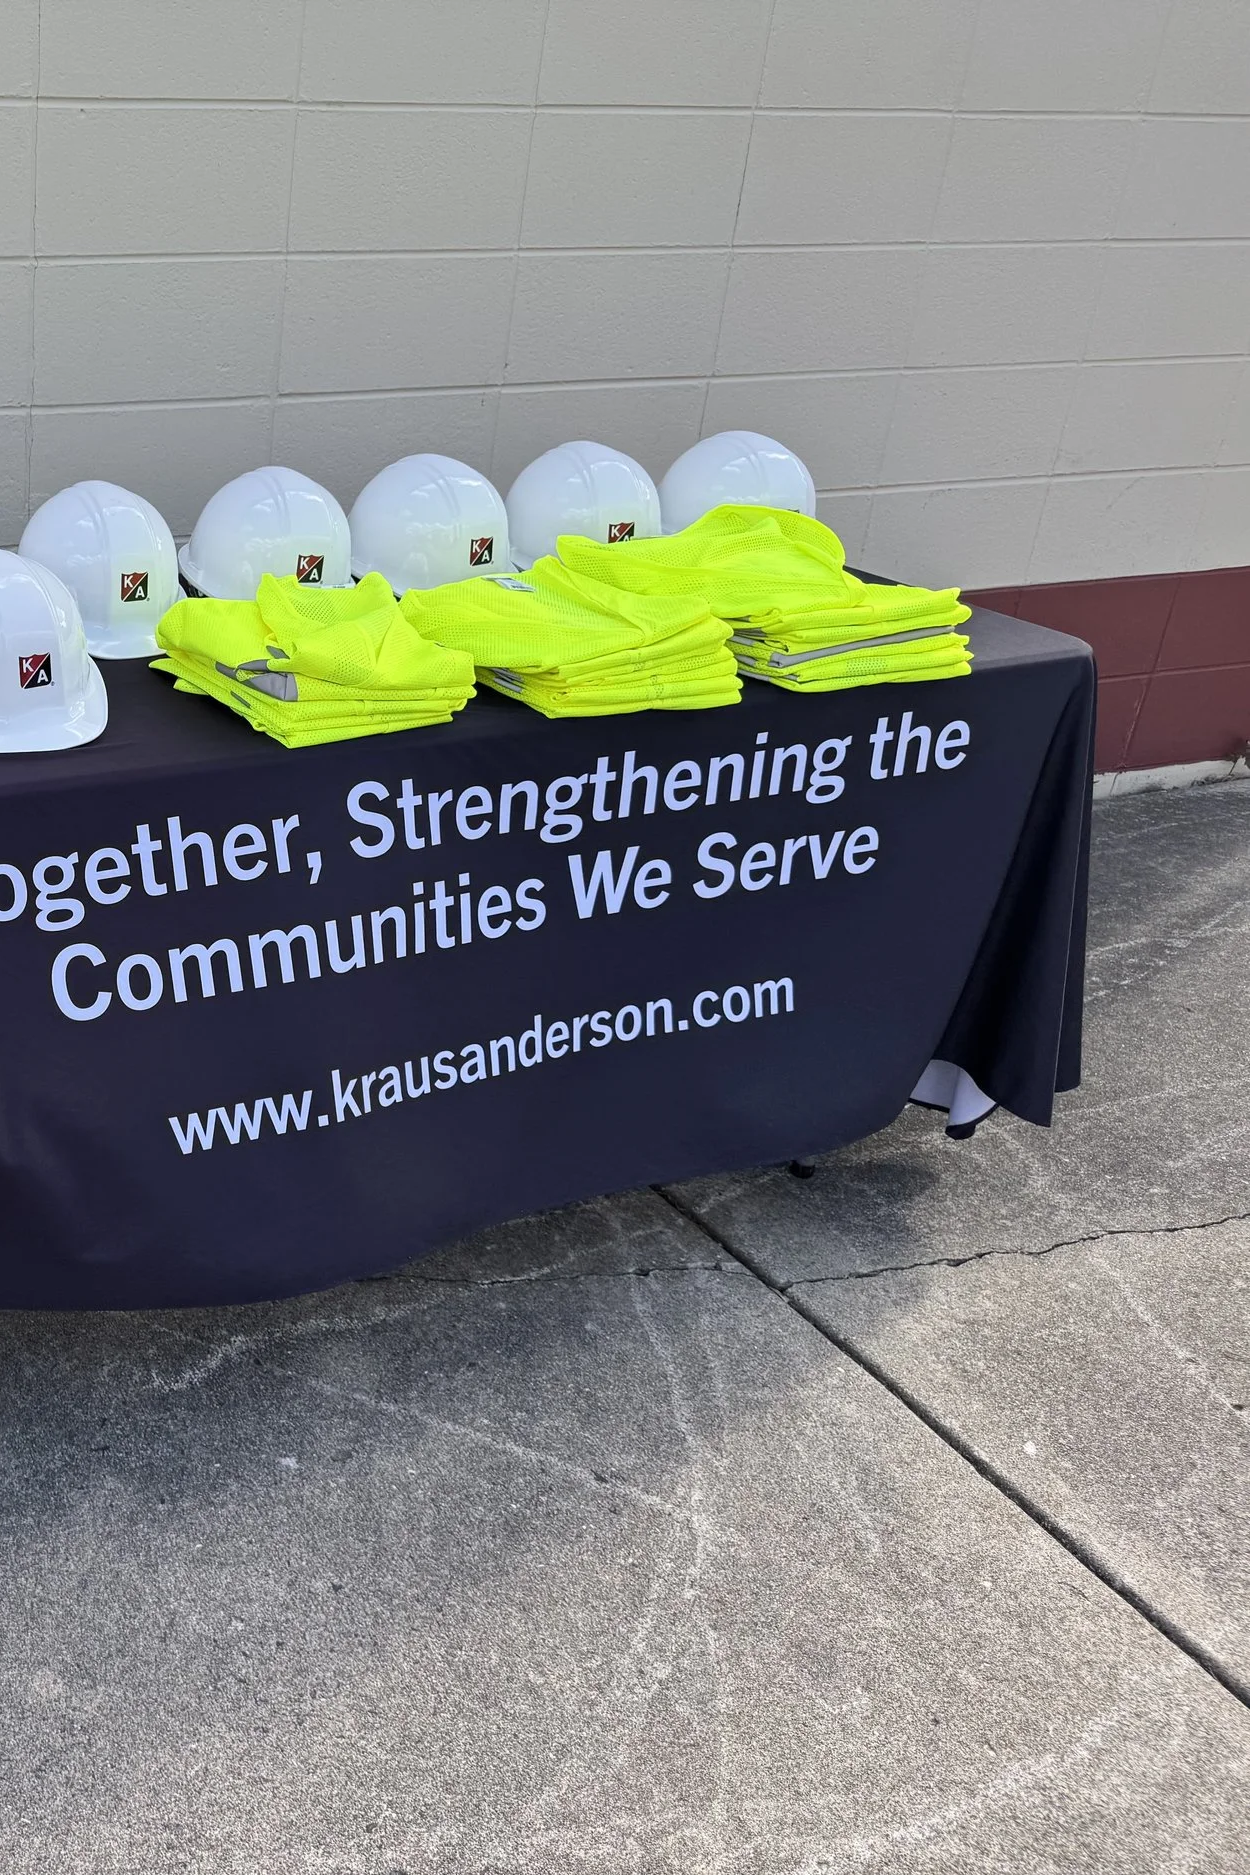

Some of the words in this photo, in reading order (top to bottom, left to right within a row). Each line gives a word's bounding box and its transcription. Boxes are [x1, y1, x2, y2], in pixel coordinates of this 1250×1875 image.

[348, 731, 853, 859] Strengthening
[869, 711, 971, 780] the
[51, 872, 547, 1022] Communities
[567, 845, 672, 920] We
[692, 825, 879, 899] Serve
[168, 977, 796, 1156] www.krausanderson.com
